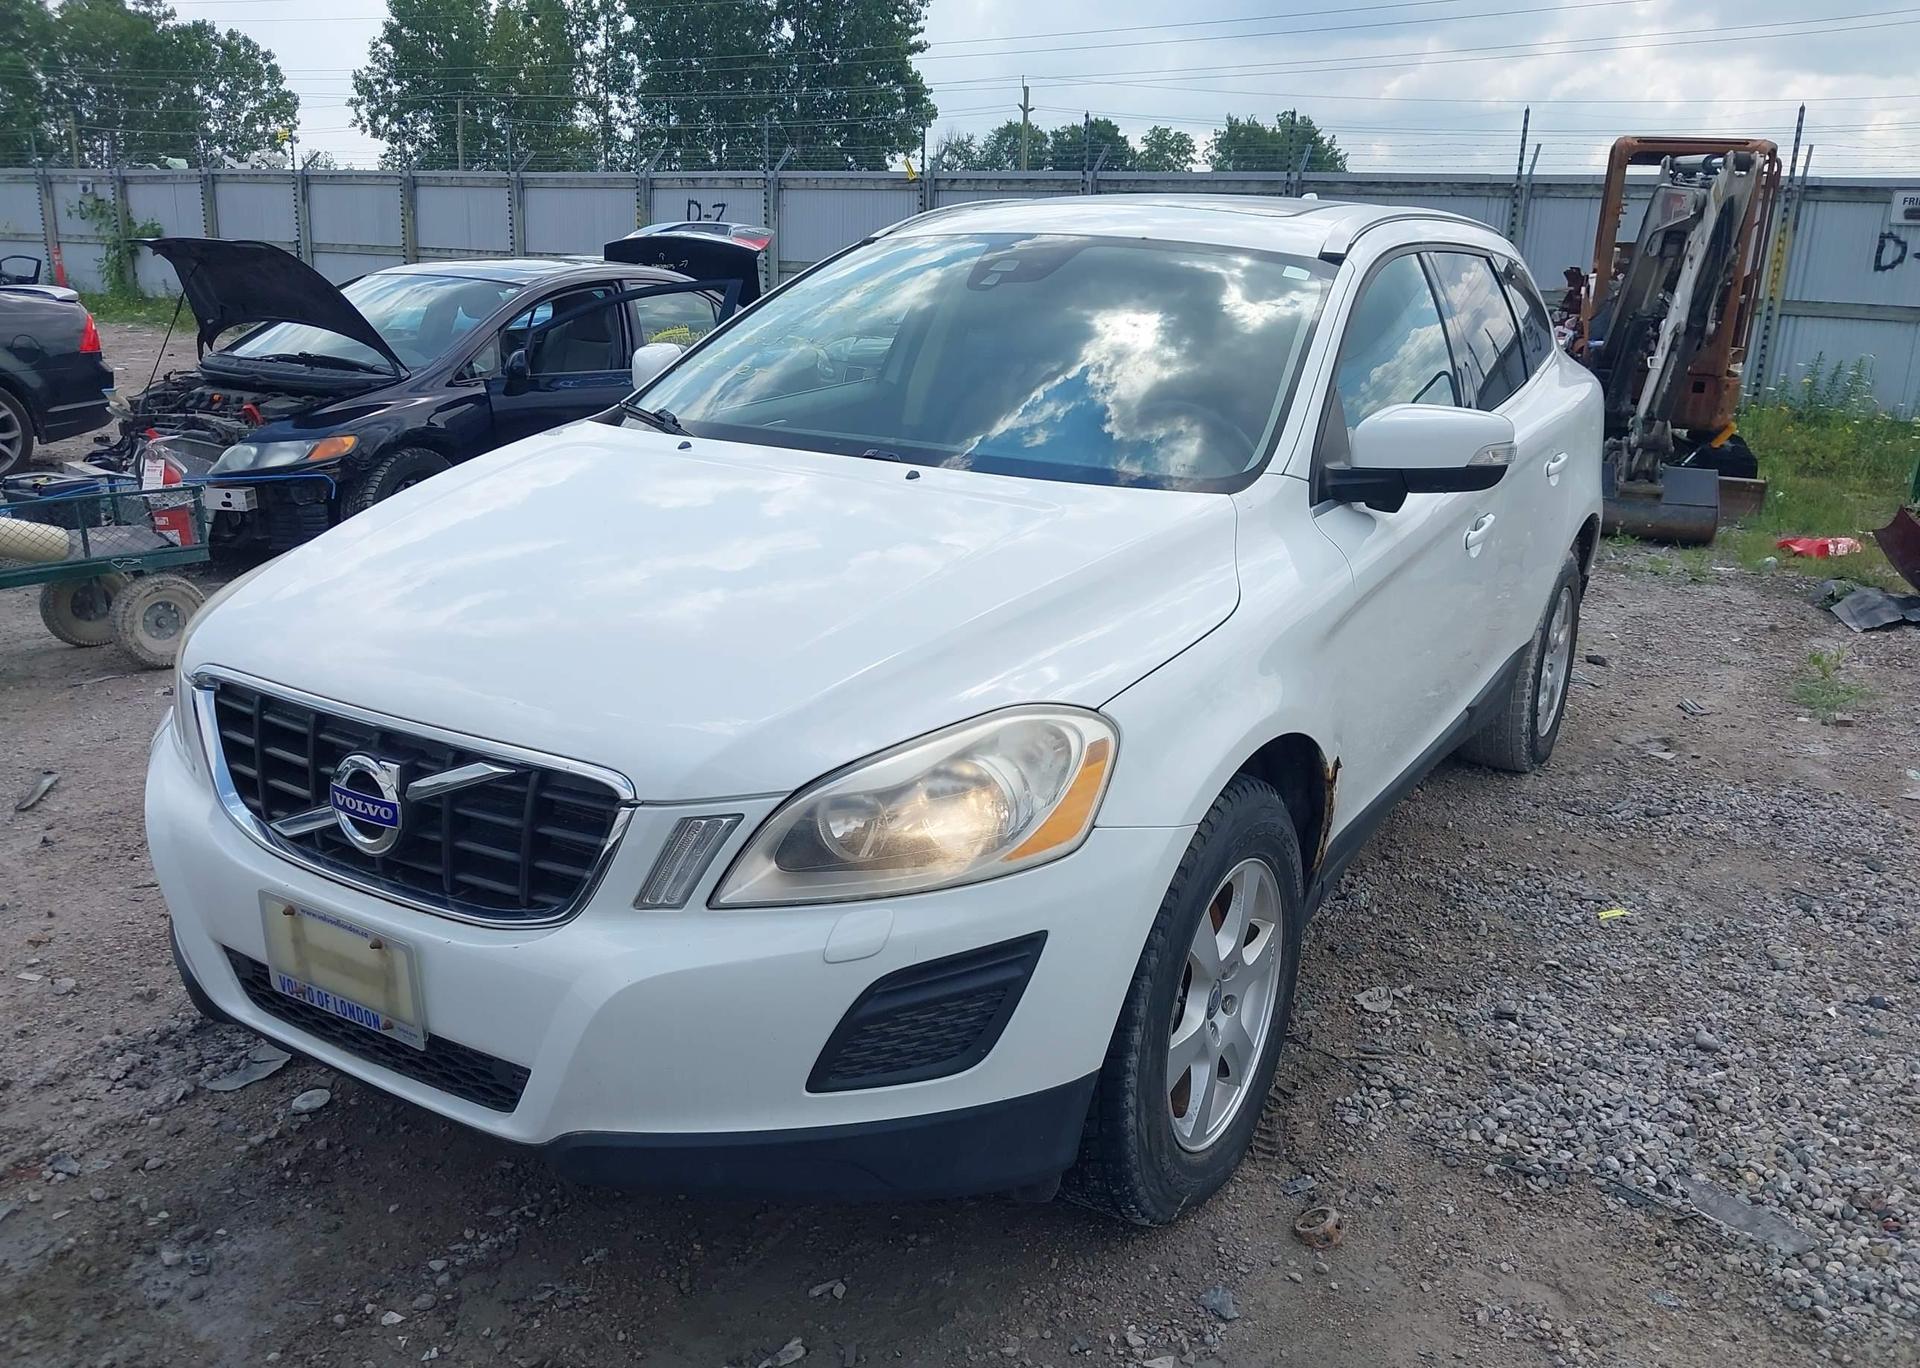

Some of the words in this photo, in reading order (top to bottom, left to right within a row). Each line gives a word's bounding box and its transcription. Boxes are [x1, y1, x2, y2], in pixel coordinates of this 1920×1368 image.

[686, 199, 727, 222] D-7
[1902, 196, 1920, 206] FRI
[334, 791, 394, 820] VOLVO
[316, 990, 331, 1010] OF
[332, 996, 381, 1032] LONDON
